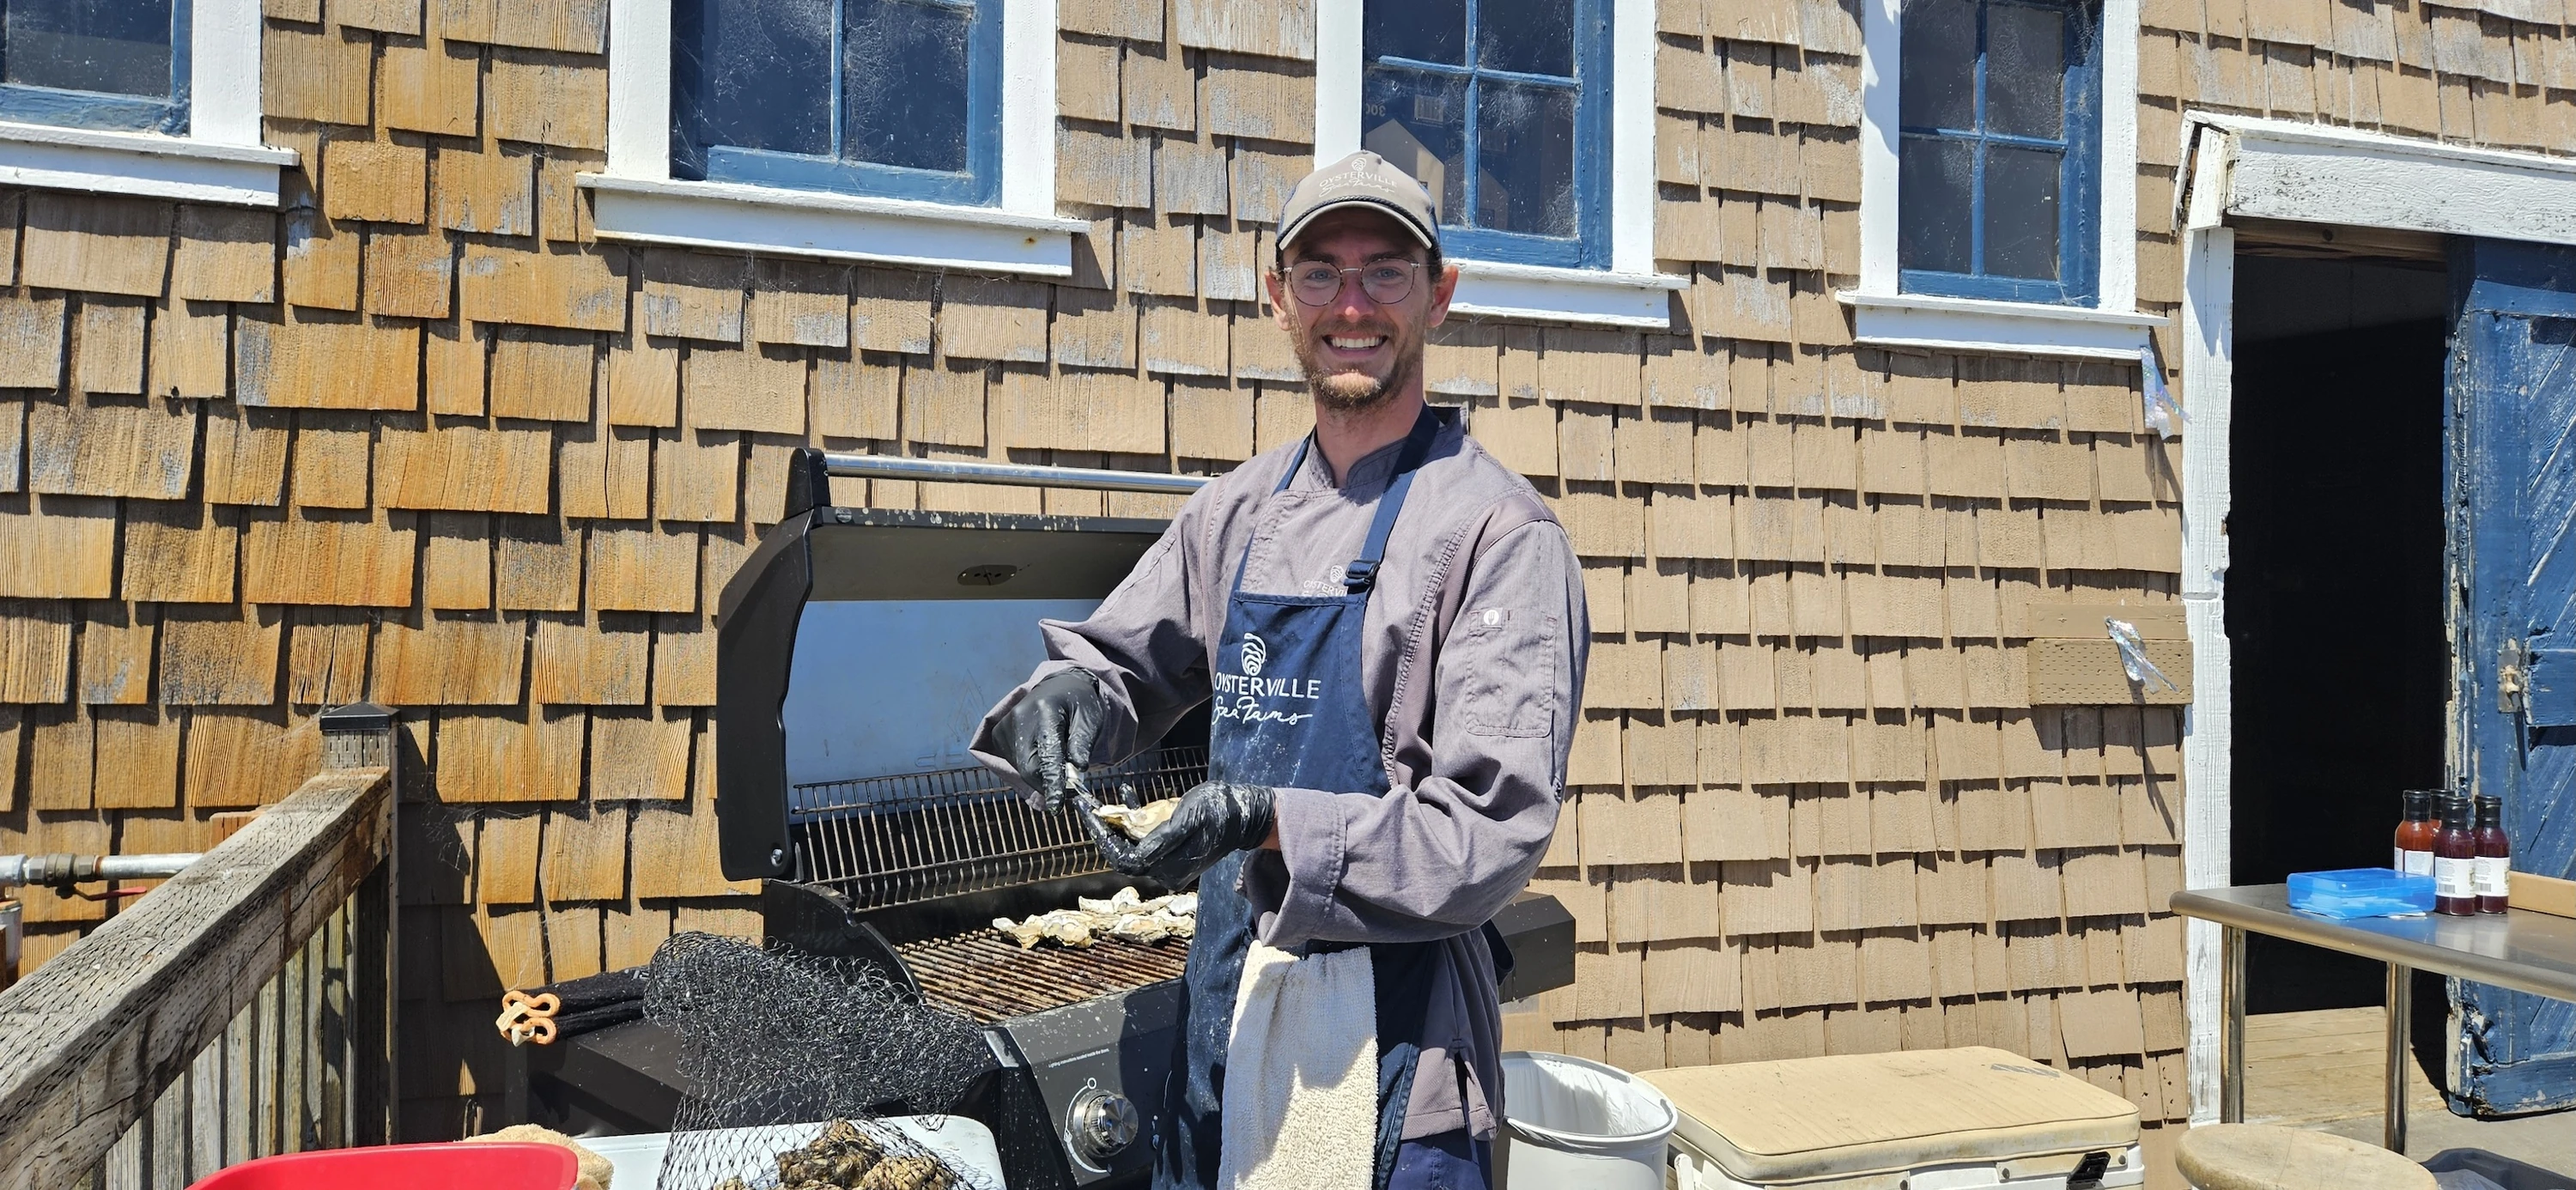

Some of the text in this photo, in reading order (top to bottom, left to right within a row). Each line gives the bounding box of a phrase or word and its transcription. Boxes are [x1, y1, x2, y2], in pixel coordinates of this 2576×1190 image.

[1319, 171, 1398, 188] OYSTERVILLE
[1215, 671, 1321, 700] OYSTERVILLE
[1212, 695, 1240, 726] Sea
